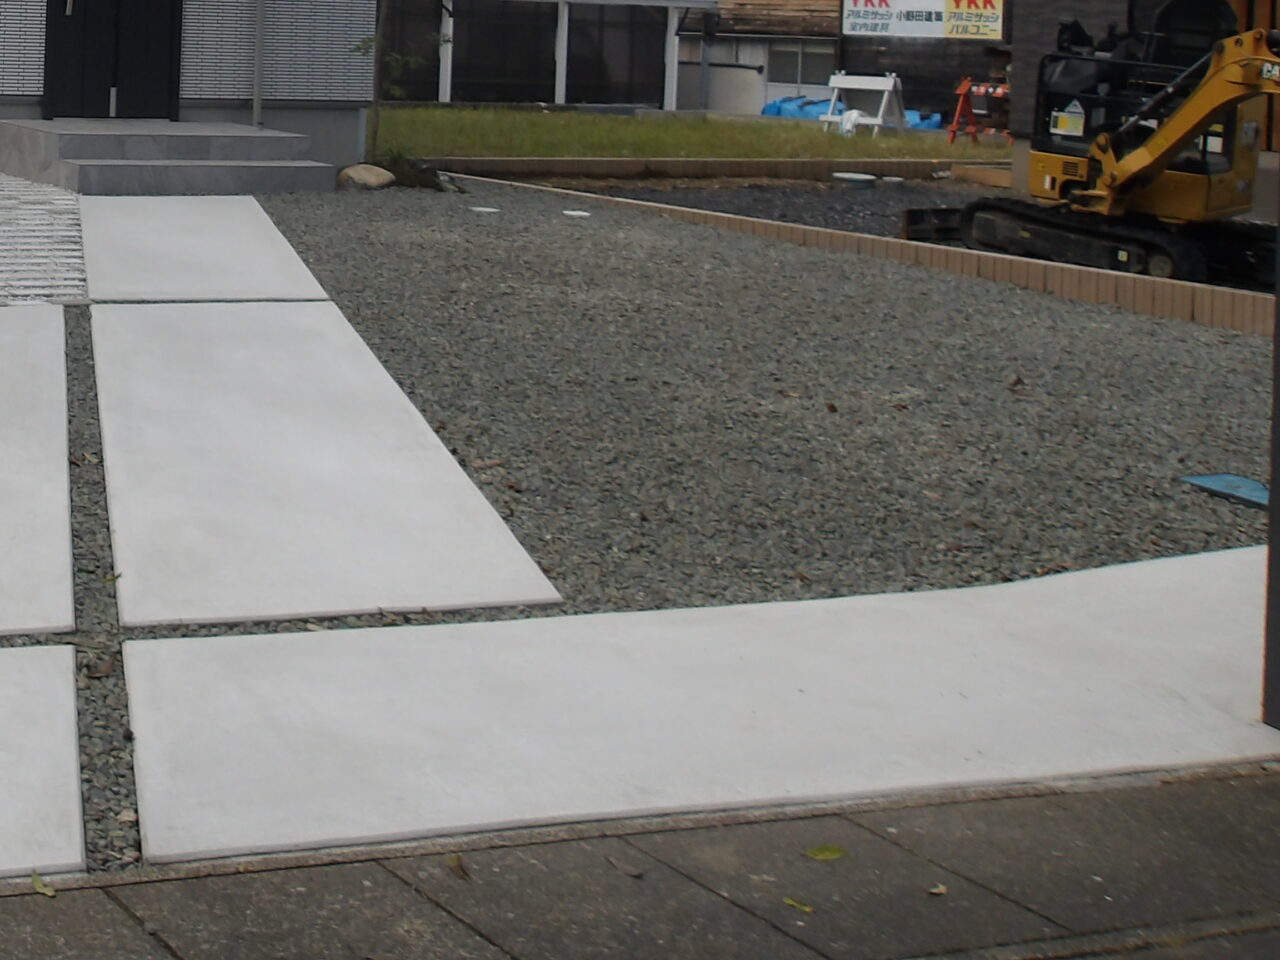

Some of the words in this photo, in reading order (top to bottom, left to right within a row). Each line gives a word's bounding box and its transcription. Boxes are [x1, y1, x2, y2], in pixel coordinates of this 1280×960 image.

[846, 9, 893, 20] アルミサッシ
[947, 11, 999, 23] アルミサッシ
